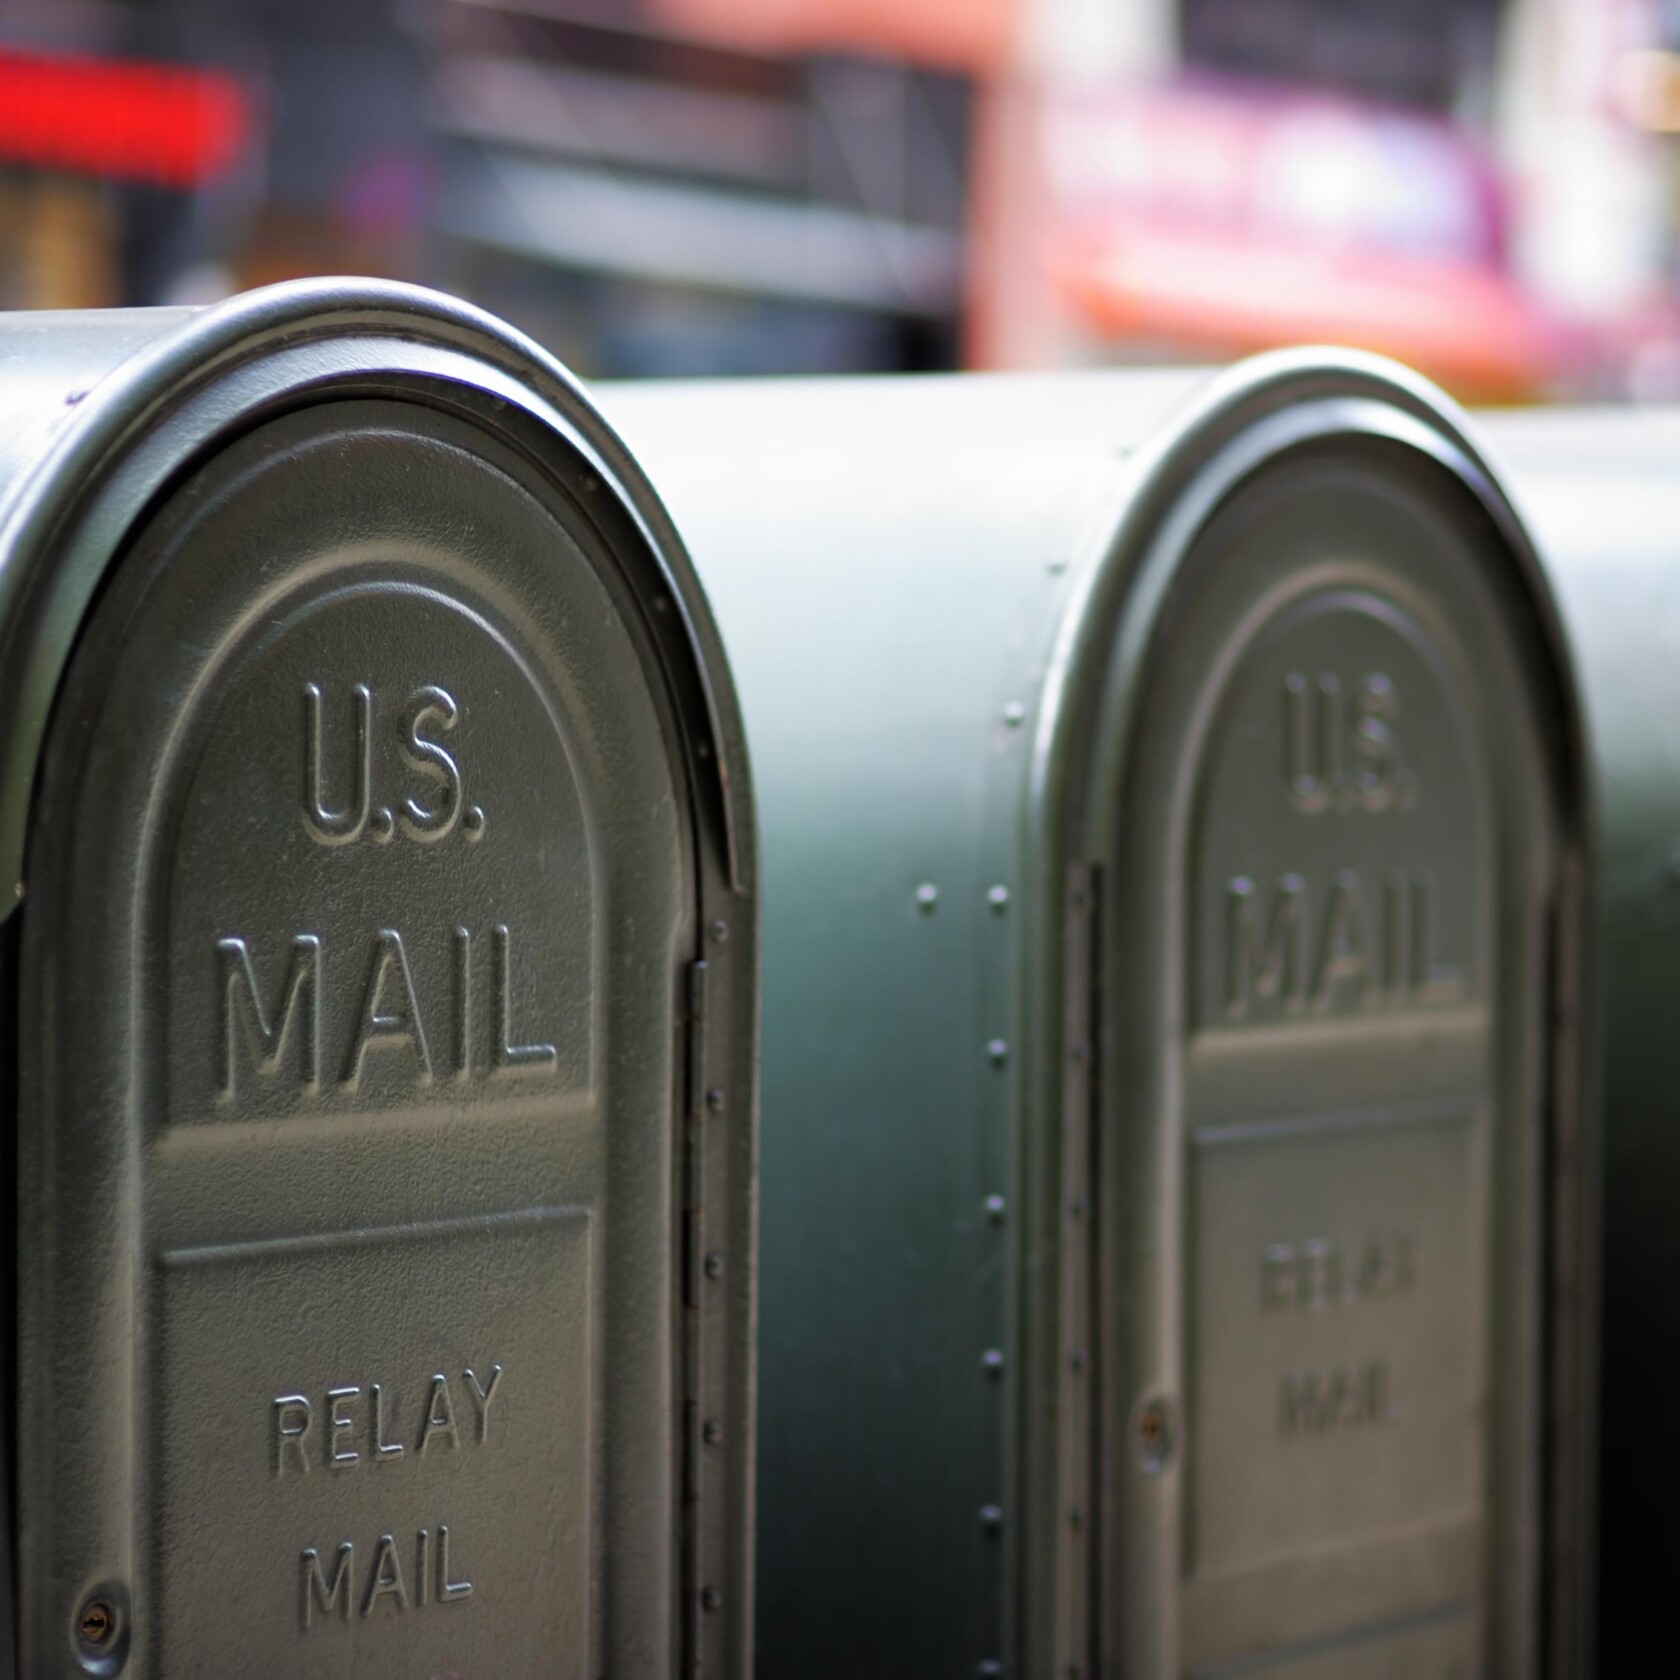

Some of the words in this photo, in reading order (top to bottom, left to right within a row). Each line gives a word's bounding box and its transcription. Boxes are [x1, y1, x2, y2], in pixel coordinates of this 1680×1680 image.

[304, 680, 486, 846] U.S.
[213, 922, 558, 1106] MAIL
[1224, 868, 1464, 1022] MAIL
[270, 1364, 503, 1480] RELAY
[300, 1525, 473, 1630] MAIL
